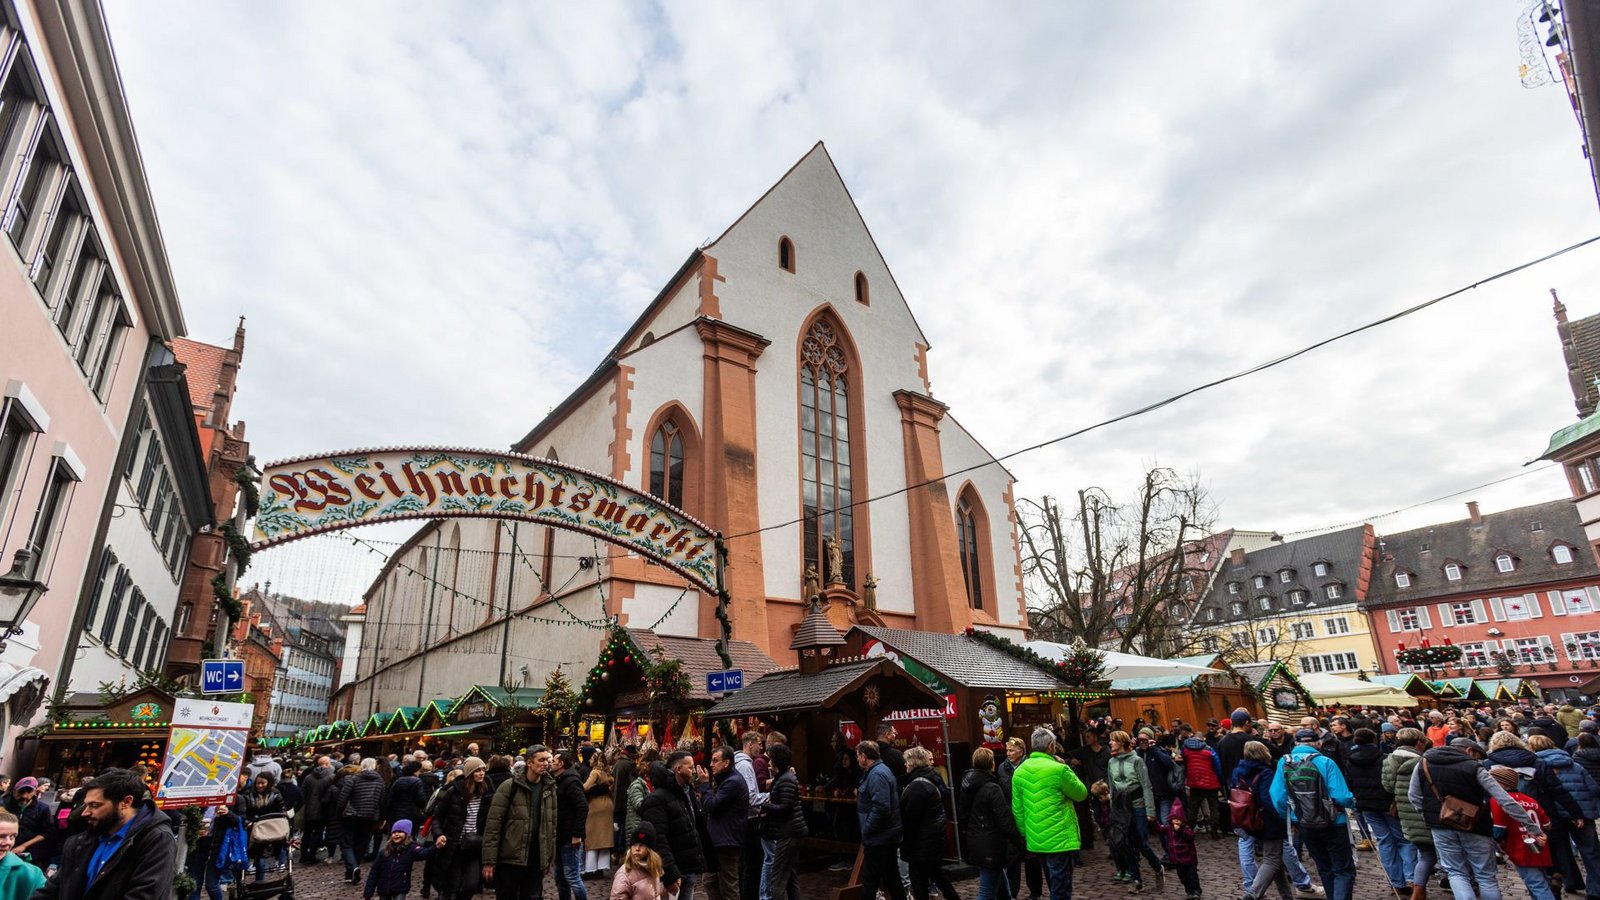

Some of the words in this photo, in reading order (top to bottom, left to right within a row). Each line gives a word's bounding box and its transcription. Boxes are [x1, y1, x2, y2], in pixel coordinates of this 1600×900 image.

[269, 461, 708, 560] Weihnachtsmarkt
[206, 670, 222, 683] WC
[726, 675, 741, 685] WC
